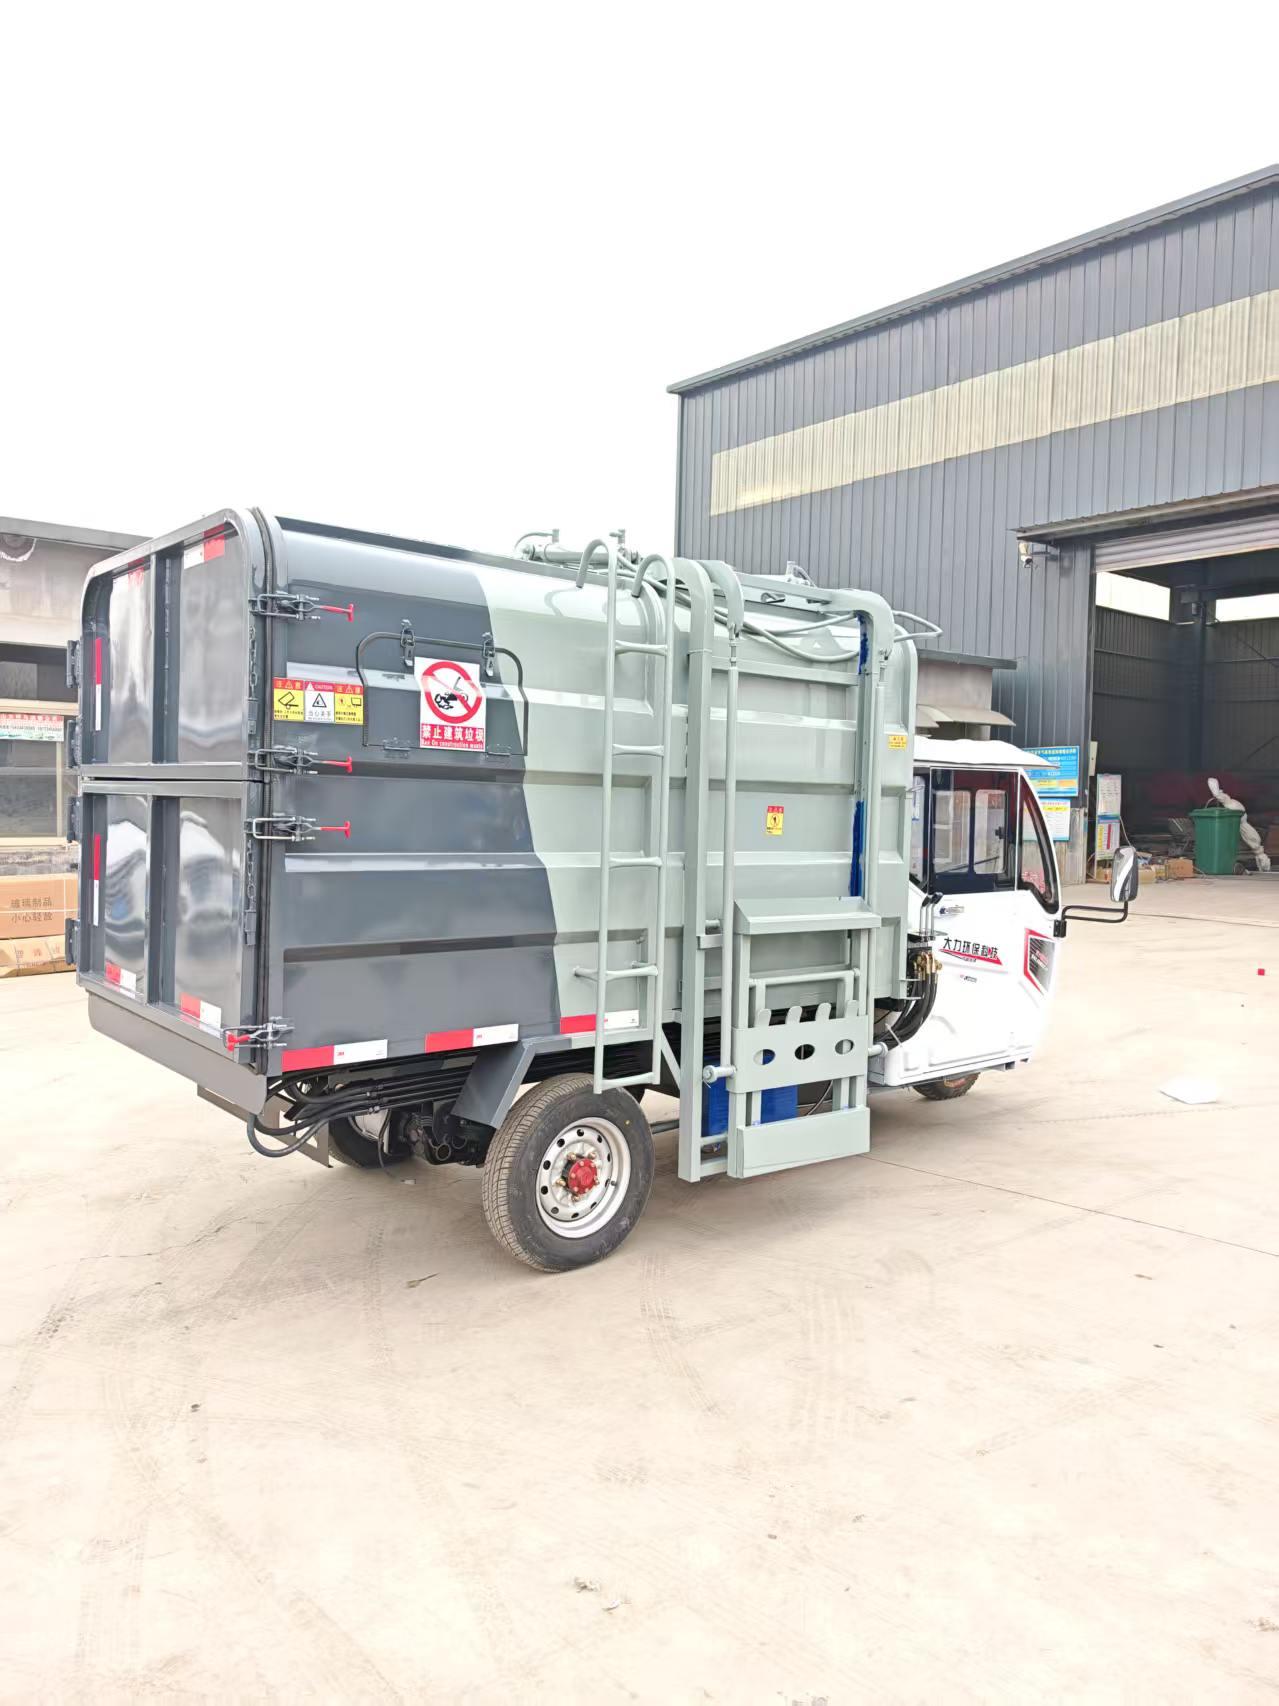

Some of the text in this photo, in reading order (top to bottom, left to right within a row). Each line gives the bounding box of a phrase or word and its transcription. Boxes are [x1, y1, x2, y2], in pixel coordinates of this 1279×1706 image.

[422, 725, 484, 742] 禁止建筑垃圾
[11, 896, 53, 908] 玻璃制品
[942, 937, 999, 959] 大力环保科技
